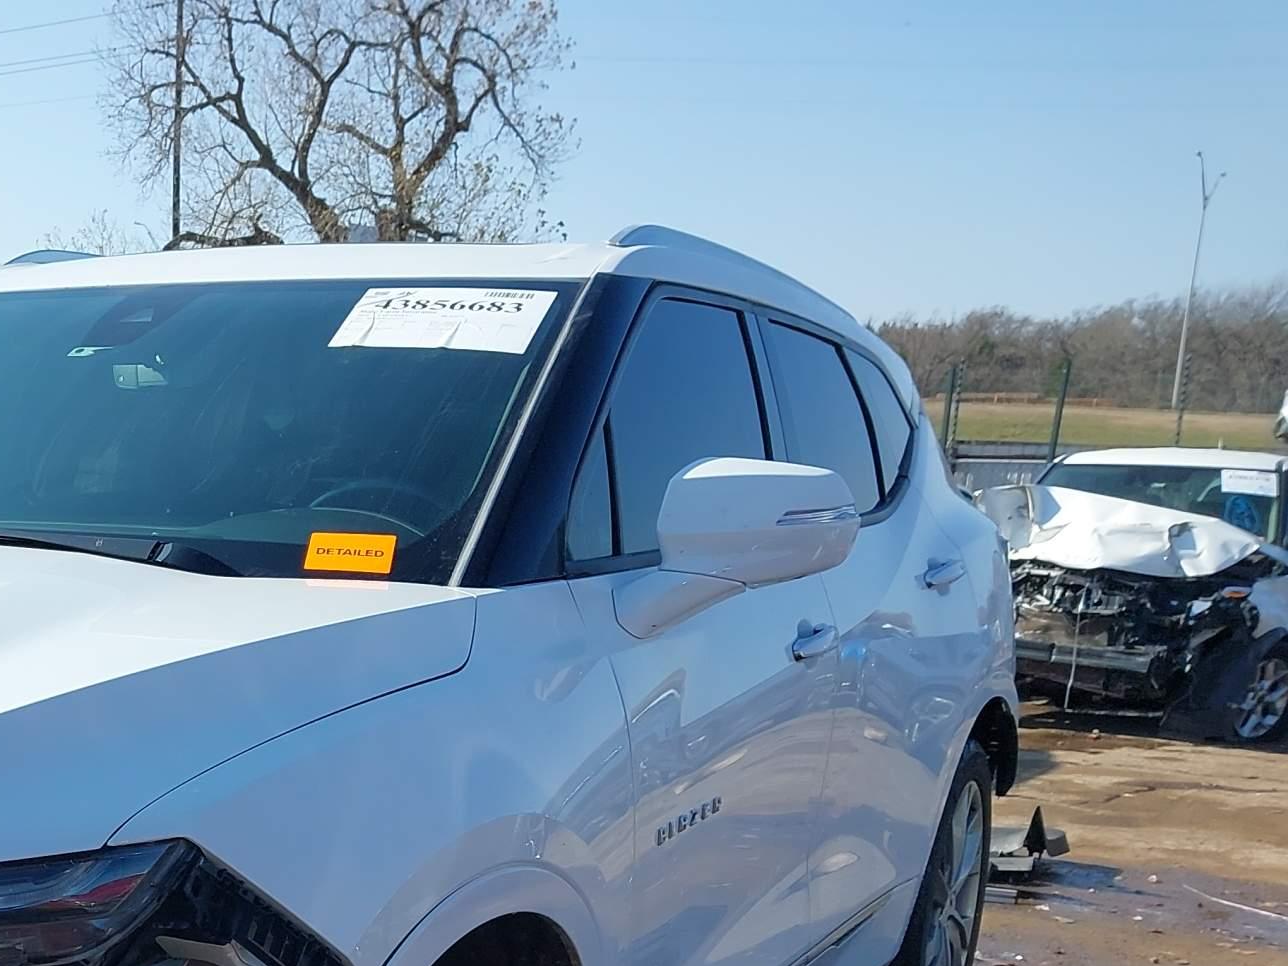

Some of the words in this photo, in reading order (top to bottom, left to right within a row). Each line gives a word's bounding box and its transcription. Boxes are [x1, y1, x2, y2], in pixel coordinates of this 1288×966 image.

[375, 298, 524, 314] 43856683
[316, 547, 384, 557] DETAILED
[656, 796, 723, 847] BLAZER
